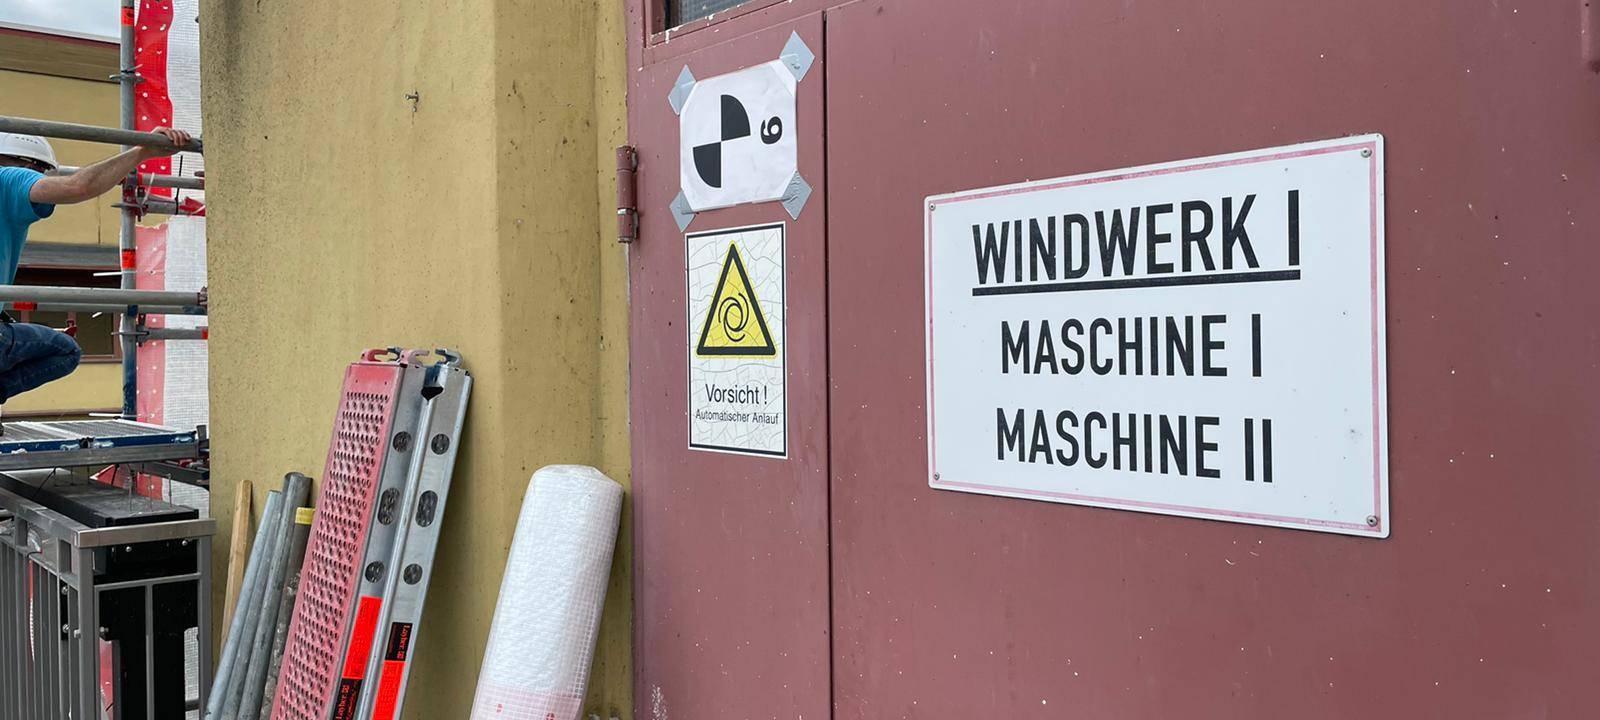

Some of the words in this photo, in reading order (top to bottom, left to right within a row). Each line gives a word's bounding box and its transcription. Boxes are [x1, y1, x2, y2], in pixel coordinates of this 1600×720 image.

[972, 194, 1260, 285] WINDWERK
[1288, 189, 1300, 266] I
[1001, 314, 1228, 377] MASCHINE
[1251, 313, 1262, 377] I
[695, 408, 750, 423] Automatischer
[752, 412, 779, 425] Anlauf
[705, 383, 759, 405] Vorsicht
[996, 407, 1221, 479] MASCHINE
[1244, 418, 1273, 483] II
